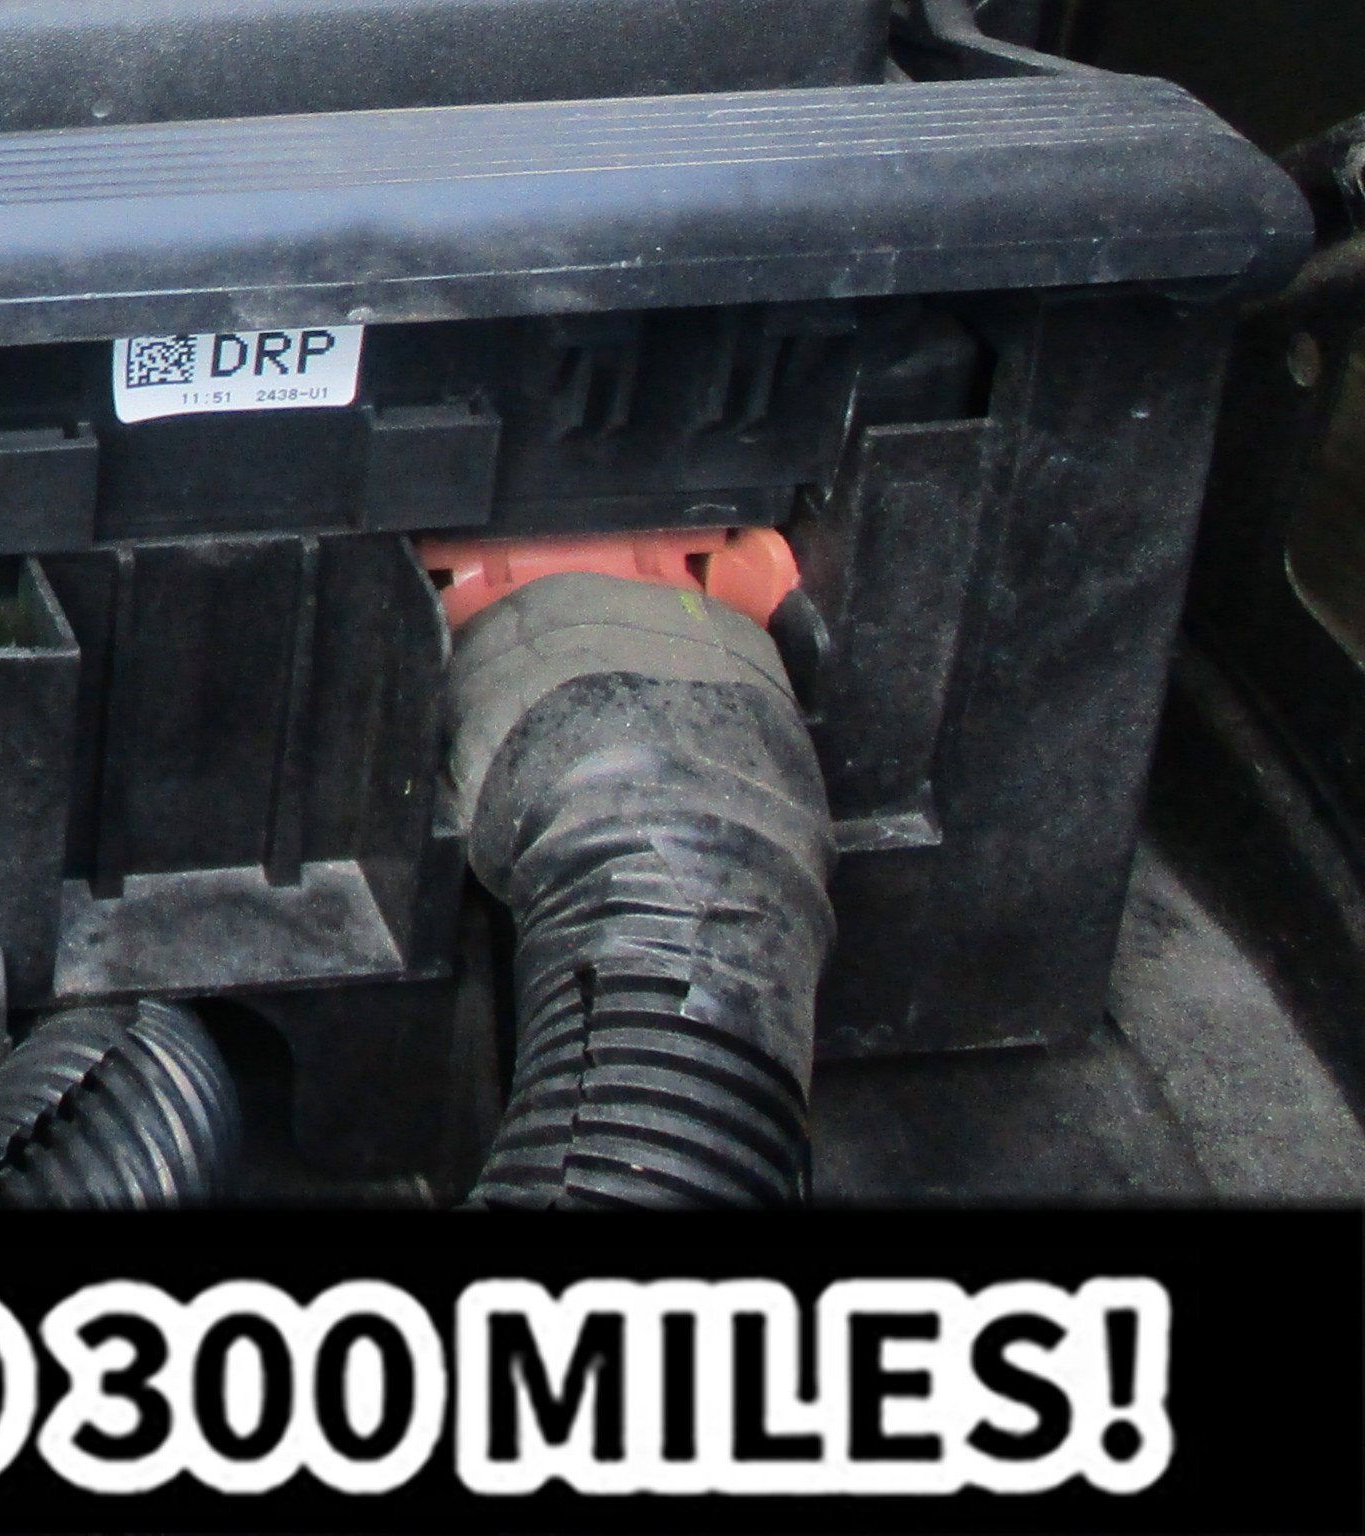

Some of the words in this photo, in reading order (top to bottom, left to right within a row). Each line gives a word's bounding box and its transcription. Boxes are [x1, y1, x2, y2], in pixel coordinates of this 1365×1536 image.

[209, 329, 336, 378] DRP
[180, 391, 233, 406] 11:51
[254, 386, 330, 403] 2438-U1
